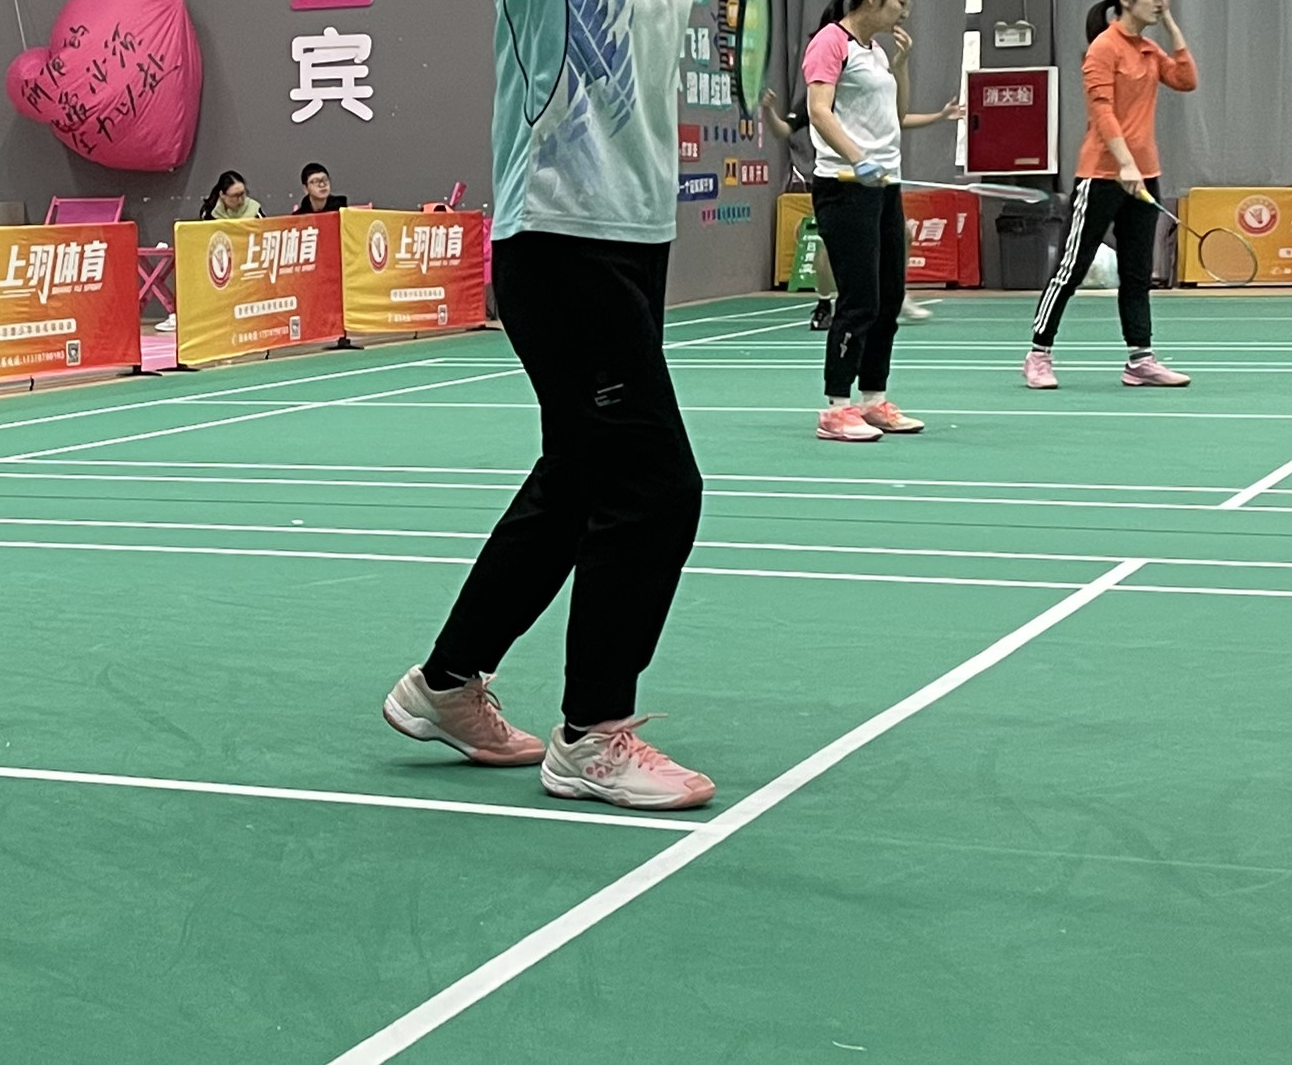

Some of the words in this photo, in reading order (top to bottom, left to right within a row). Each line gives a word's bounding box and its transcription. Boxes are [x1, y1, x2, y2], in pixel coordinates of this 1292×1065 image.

[985, 86, 1030, 103] 消火栓
[239, 226, 319, 284] 上羽体育
[394, 224, 464, 274] 上羽体育
